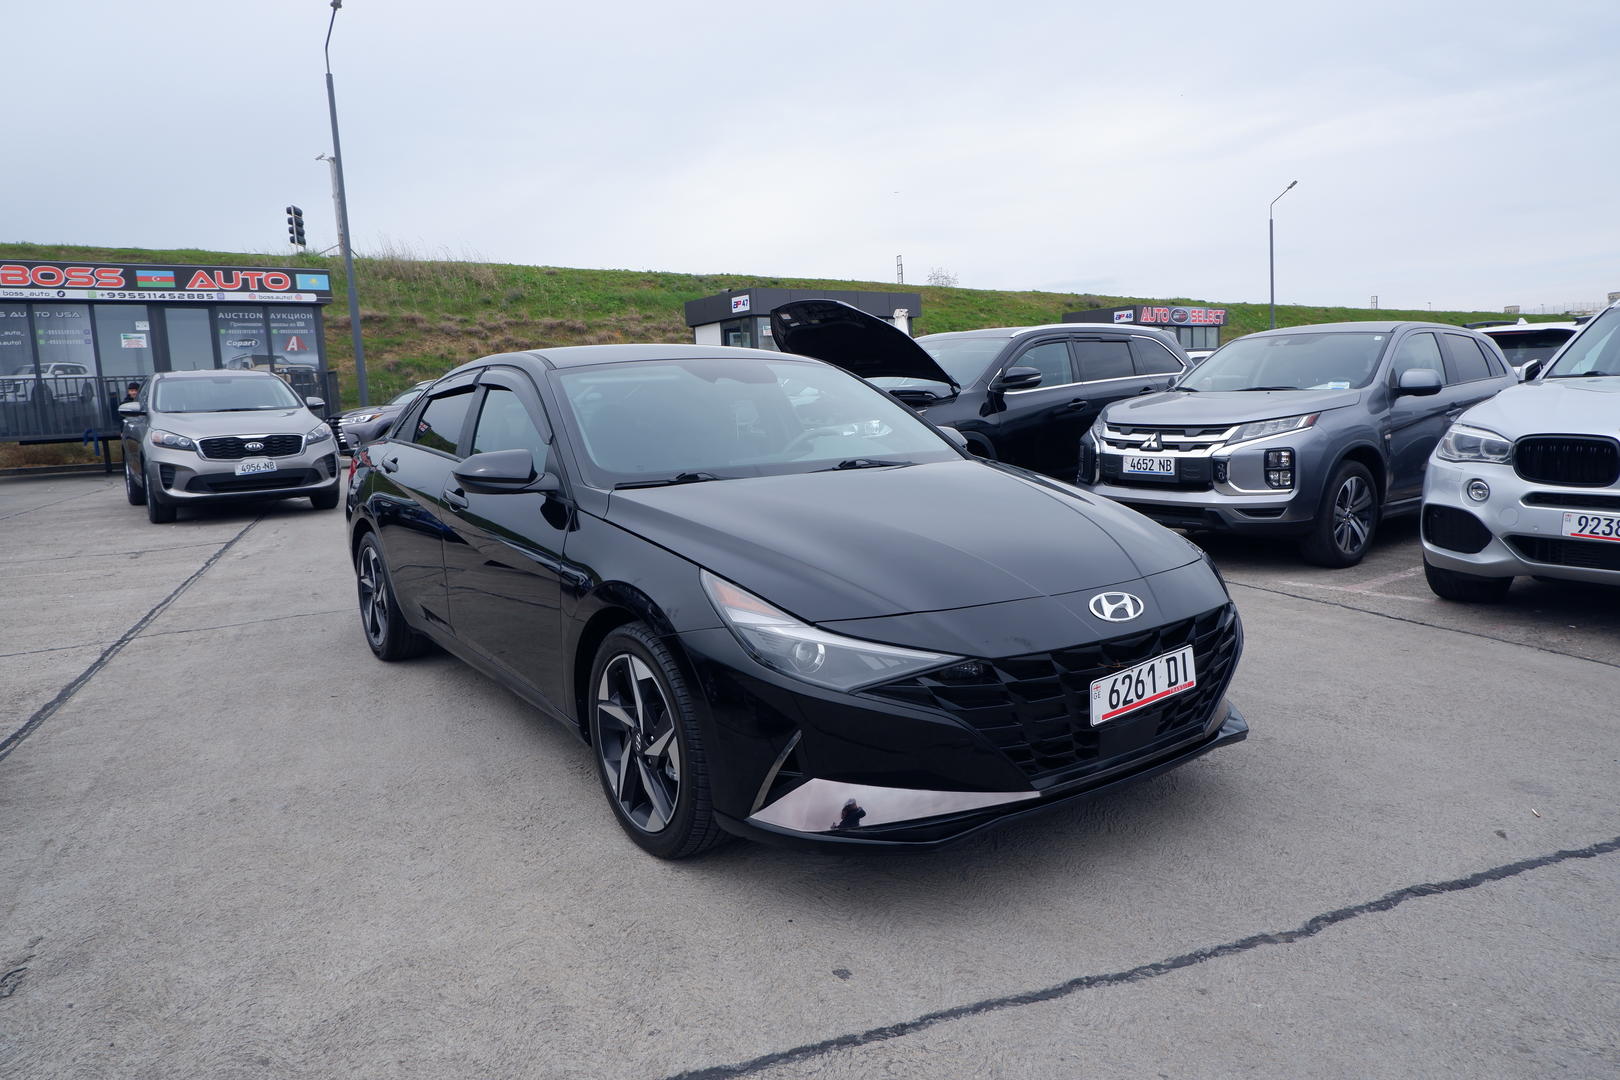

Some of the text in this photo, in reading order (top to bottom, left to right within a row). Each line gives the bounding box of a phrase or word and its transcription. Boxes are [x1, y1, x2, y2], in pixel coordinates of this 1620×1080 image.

[0, 265, 290, 291] BOSS AUTO
[100, 291, 214, 300] +995511452885
[1140, 307, 1169, 323] AUTO
[1190, 309, 1225, 324] SELECT
[226, 339, 257, 347] Copart
[1130, 458, 1172, 472] 4652 NB
[1108, 652, 1188, 710] 6261 DI
